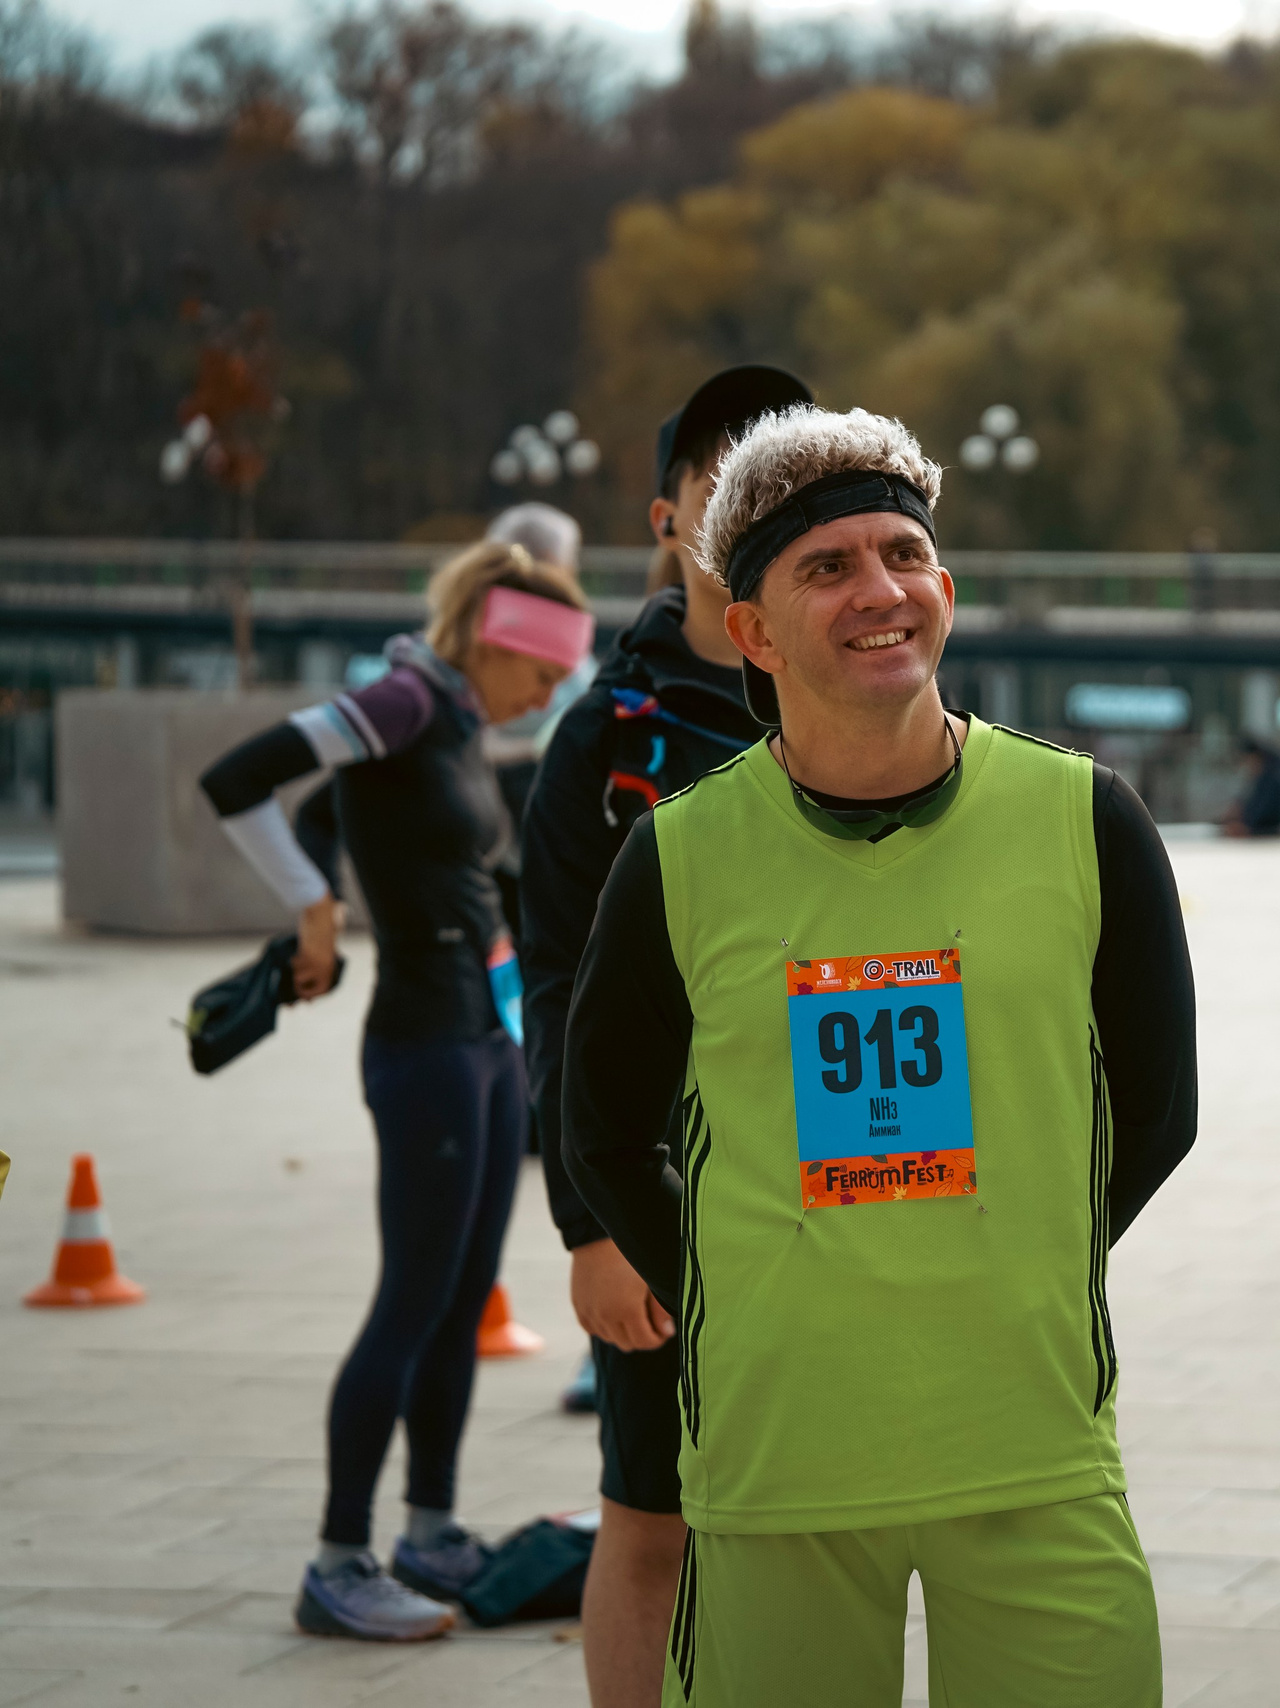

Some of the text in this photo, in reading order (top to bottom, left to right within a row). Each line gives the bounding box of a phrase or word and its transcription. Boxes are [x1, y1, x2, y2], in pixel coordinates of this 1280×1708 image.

[818, 1005, 943, 1093] 913
[869, 1097, 898, 1121] NH3
[869, 1124, 901, 1138] Аммиак
